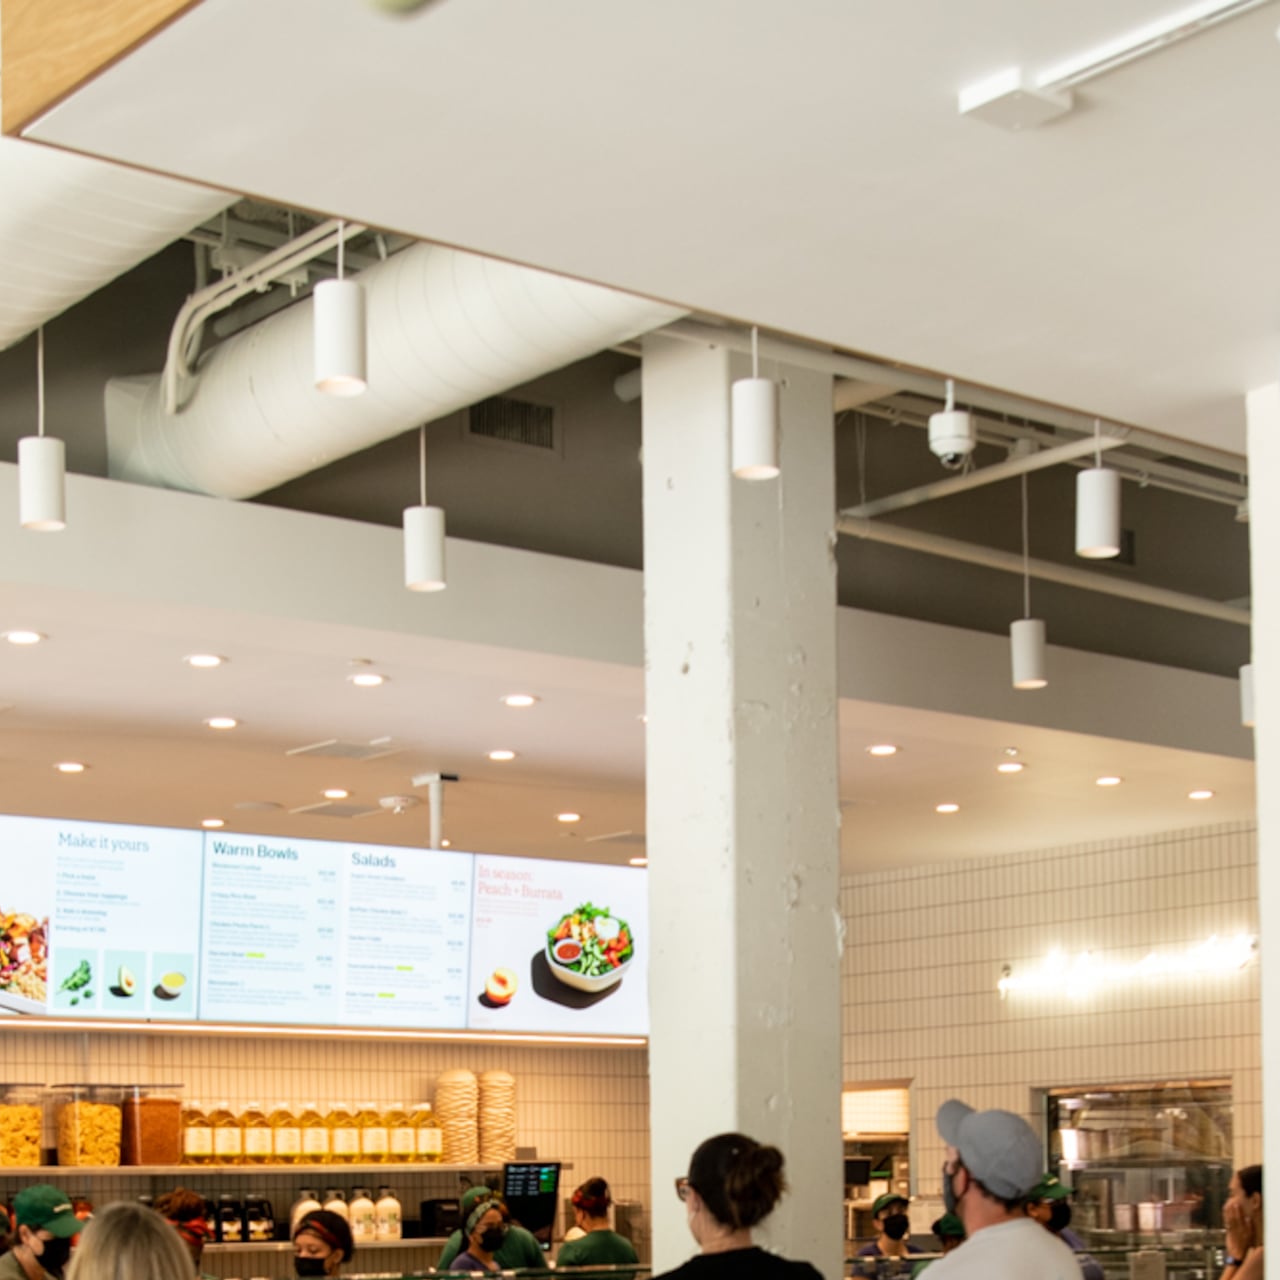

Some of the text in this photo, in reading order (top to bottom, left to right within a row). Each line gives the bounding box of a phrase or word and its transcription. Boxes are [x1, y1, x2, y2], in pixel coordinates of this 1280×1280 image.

[58, 832, 149, 853] Make it yours
[212, 841, 298, 861] Warm Bowls
[351, 852, 396, 868] Salads
[478, 880, 512, 896] Peach
